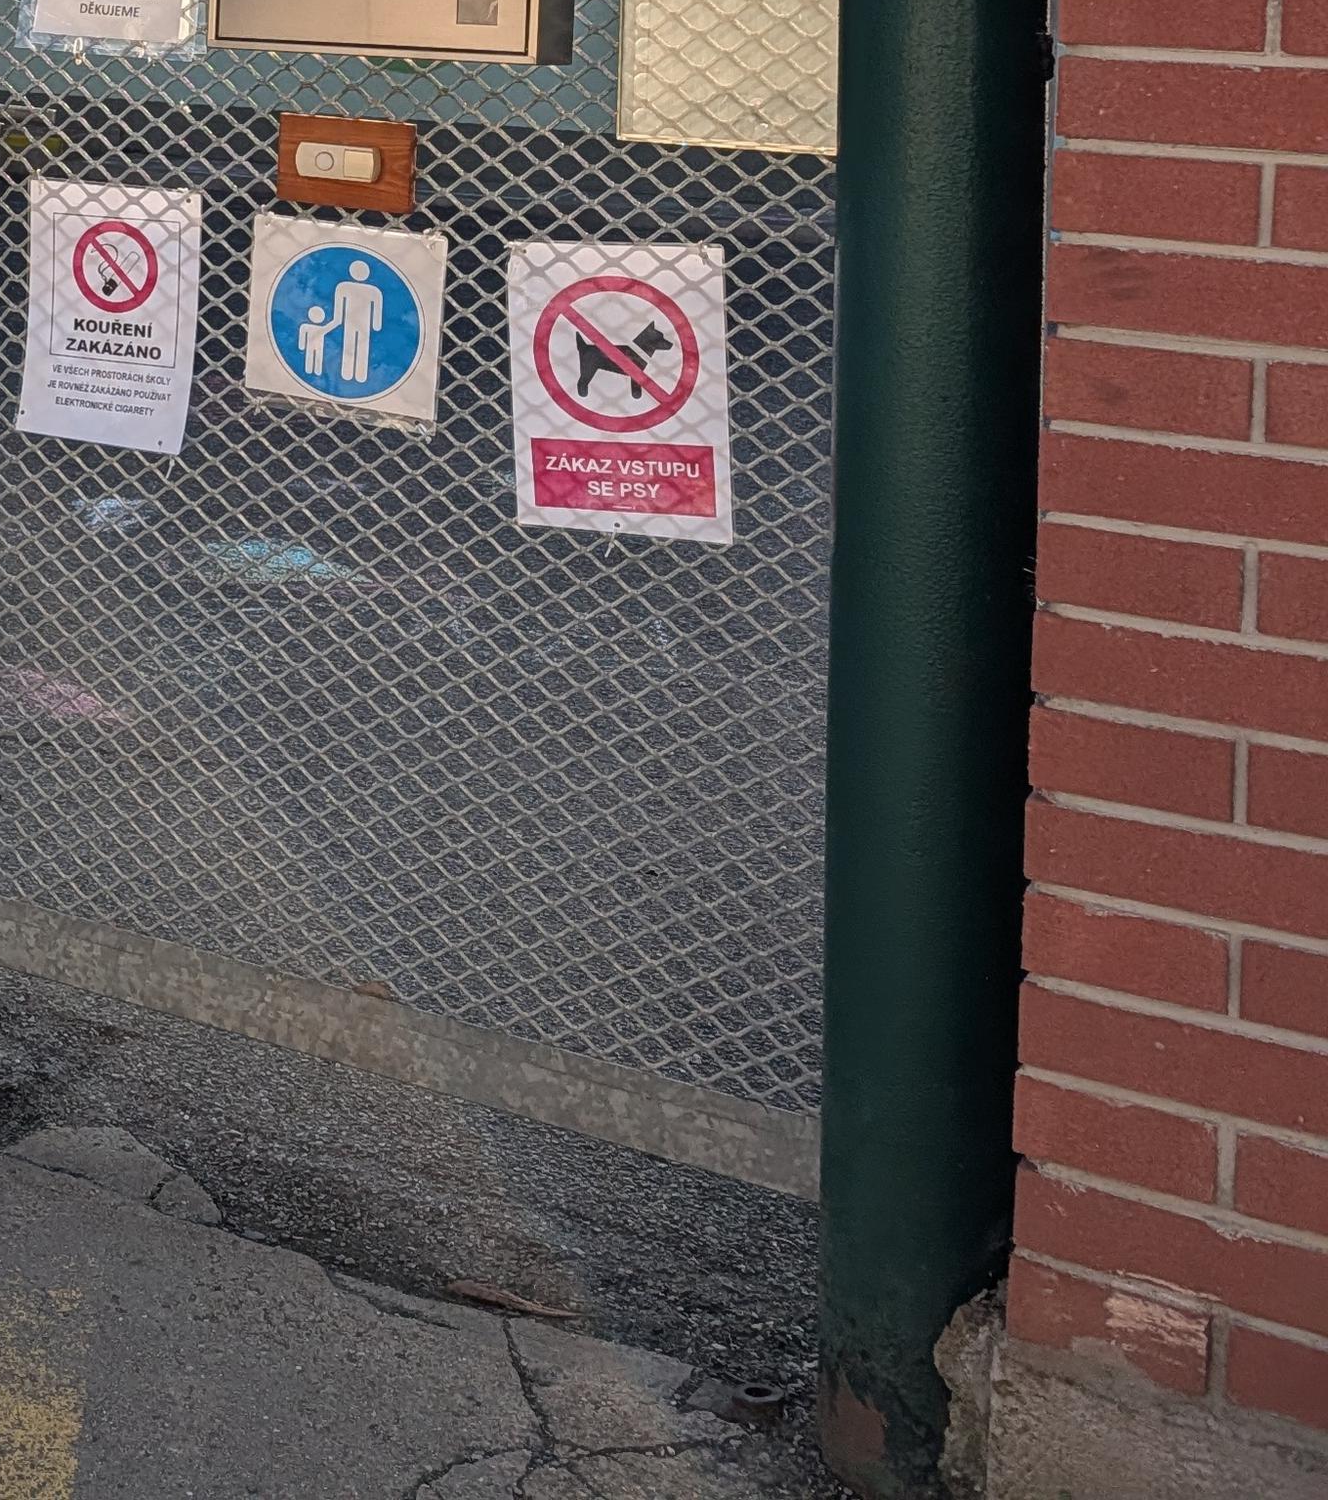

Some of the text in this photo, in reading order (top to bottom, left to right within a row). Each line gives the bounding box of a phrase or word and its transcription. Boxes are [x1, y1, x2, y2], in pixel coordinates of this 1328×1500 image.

[79, 1, 141, 18] DĚKUJEME
[73, 318, 153, 339] KOUŘENÍ
[65, 337, 162, 361] ZAKÁZÁNO
[52, 364, 172, 387] VE VŠECH PROSTORÁCH ŠKOLY
[47, 380, 57, 389] JE
[90, 385, 132, 398] ZAKÁZÁNO
[55, 396, 155, 417] ELEKTRONICKÉ CIGARETY
[545, 453, 700, 479] ZÁKAZ VSTUPU
[588, 481, 660, 499] SE PSY
